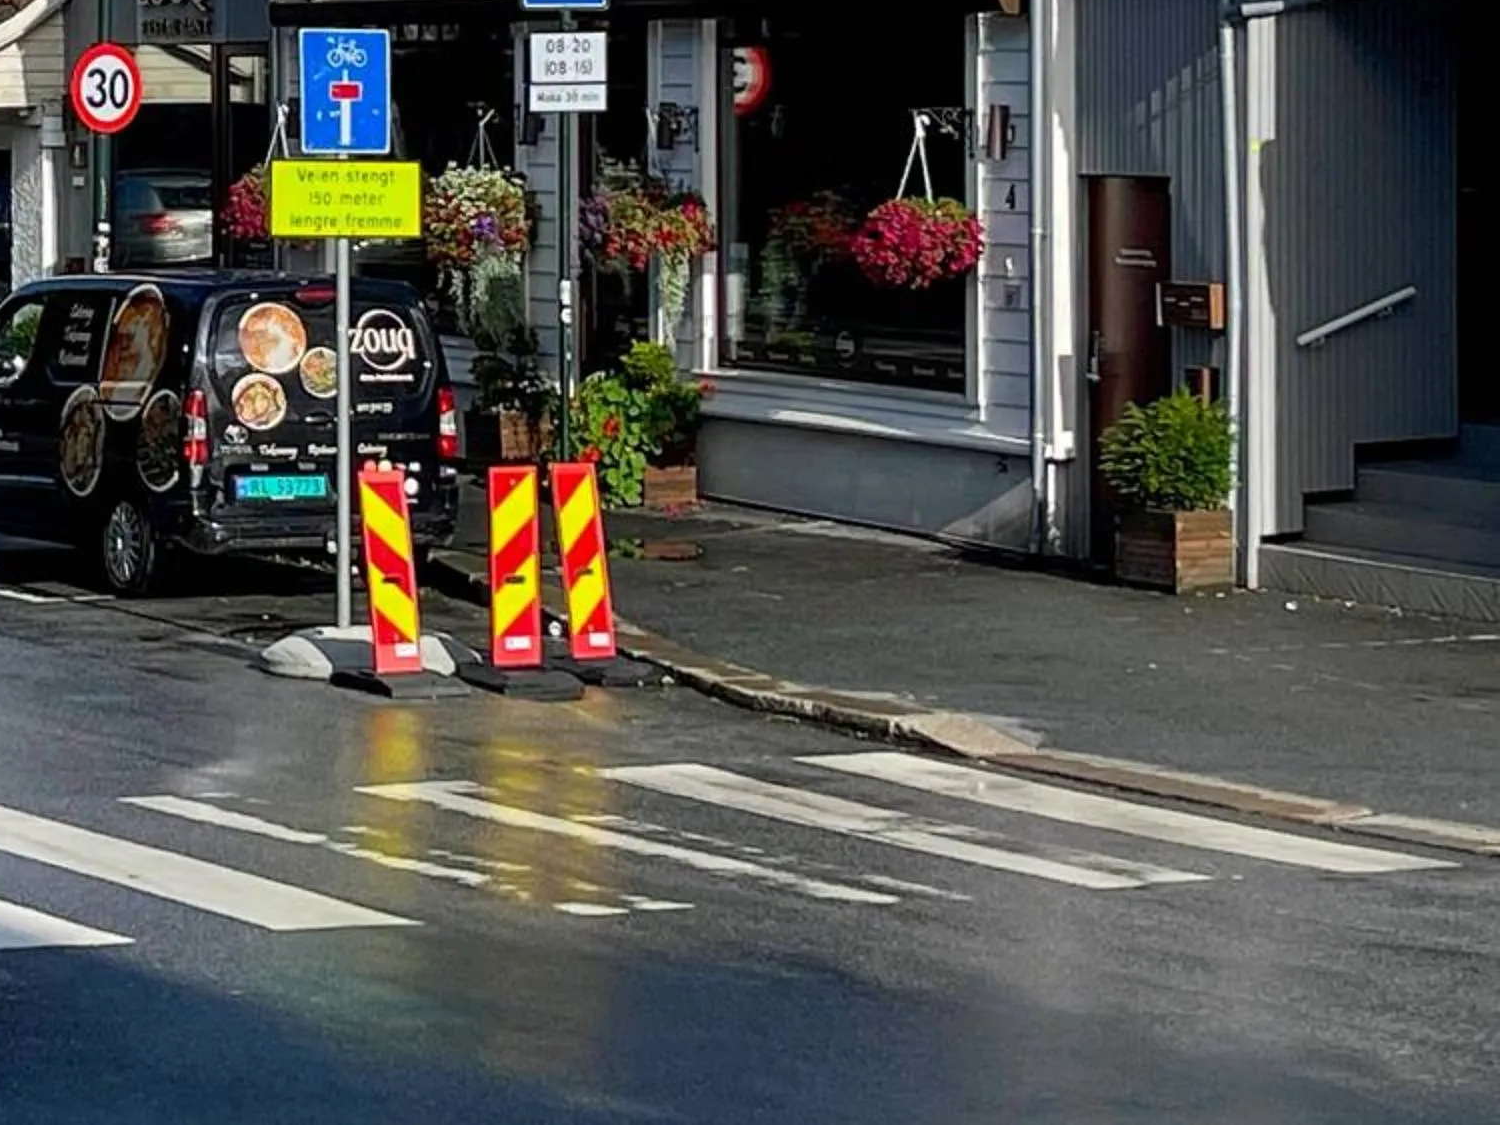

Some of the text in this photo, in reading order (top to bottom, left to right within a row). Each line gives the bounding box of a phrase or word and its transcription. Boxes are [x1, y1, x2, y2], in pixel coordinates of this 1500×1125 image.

[86, 67, 129, 110] 30
[346, 168, 396, 188] stengt
[308, 191, 386, 206] 150 meter
[1004, 183, 1016, 210] 4
[345, 212, 403, 228] fremme
[347, 327, 416, 360] zouq
